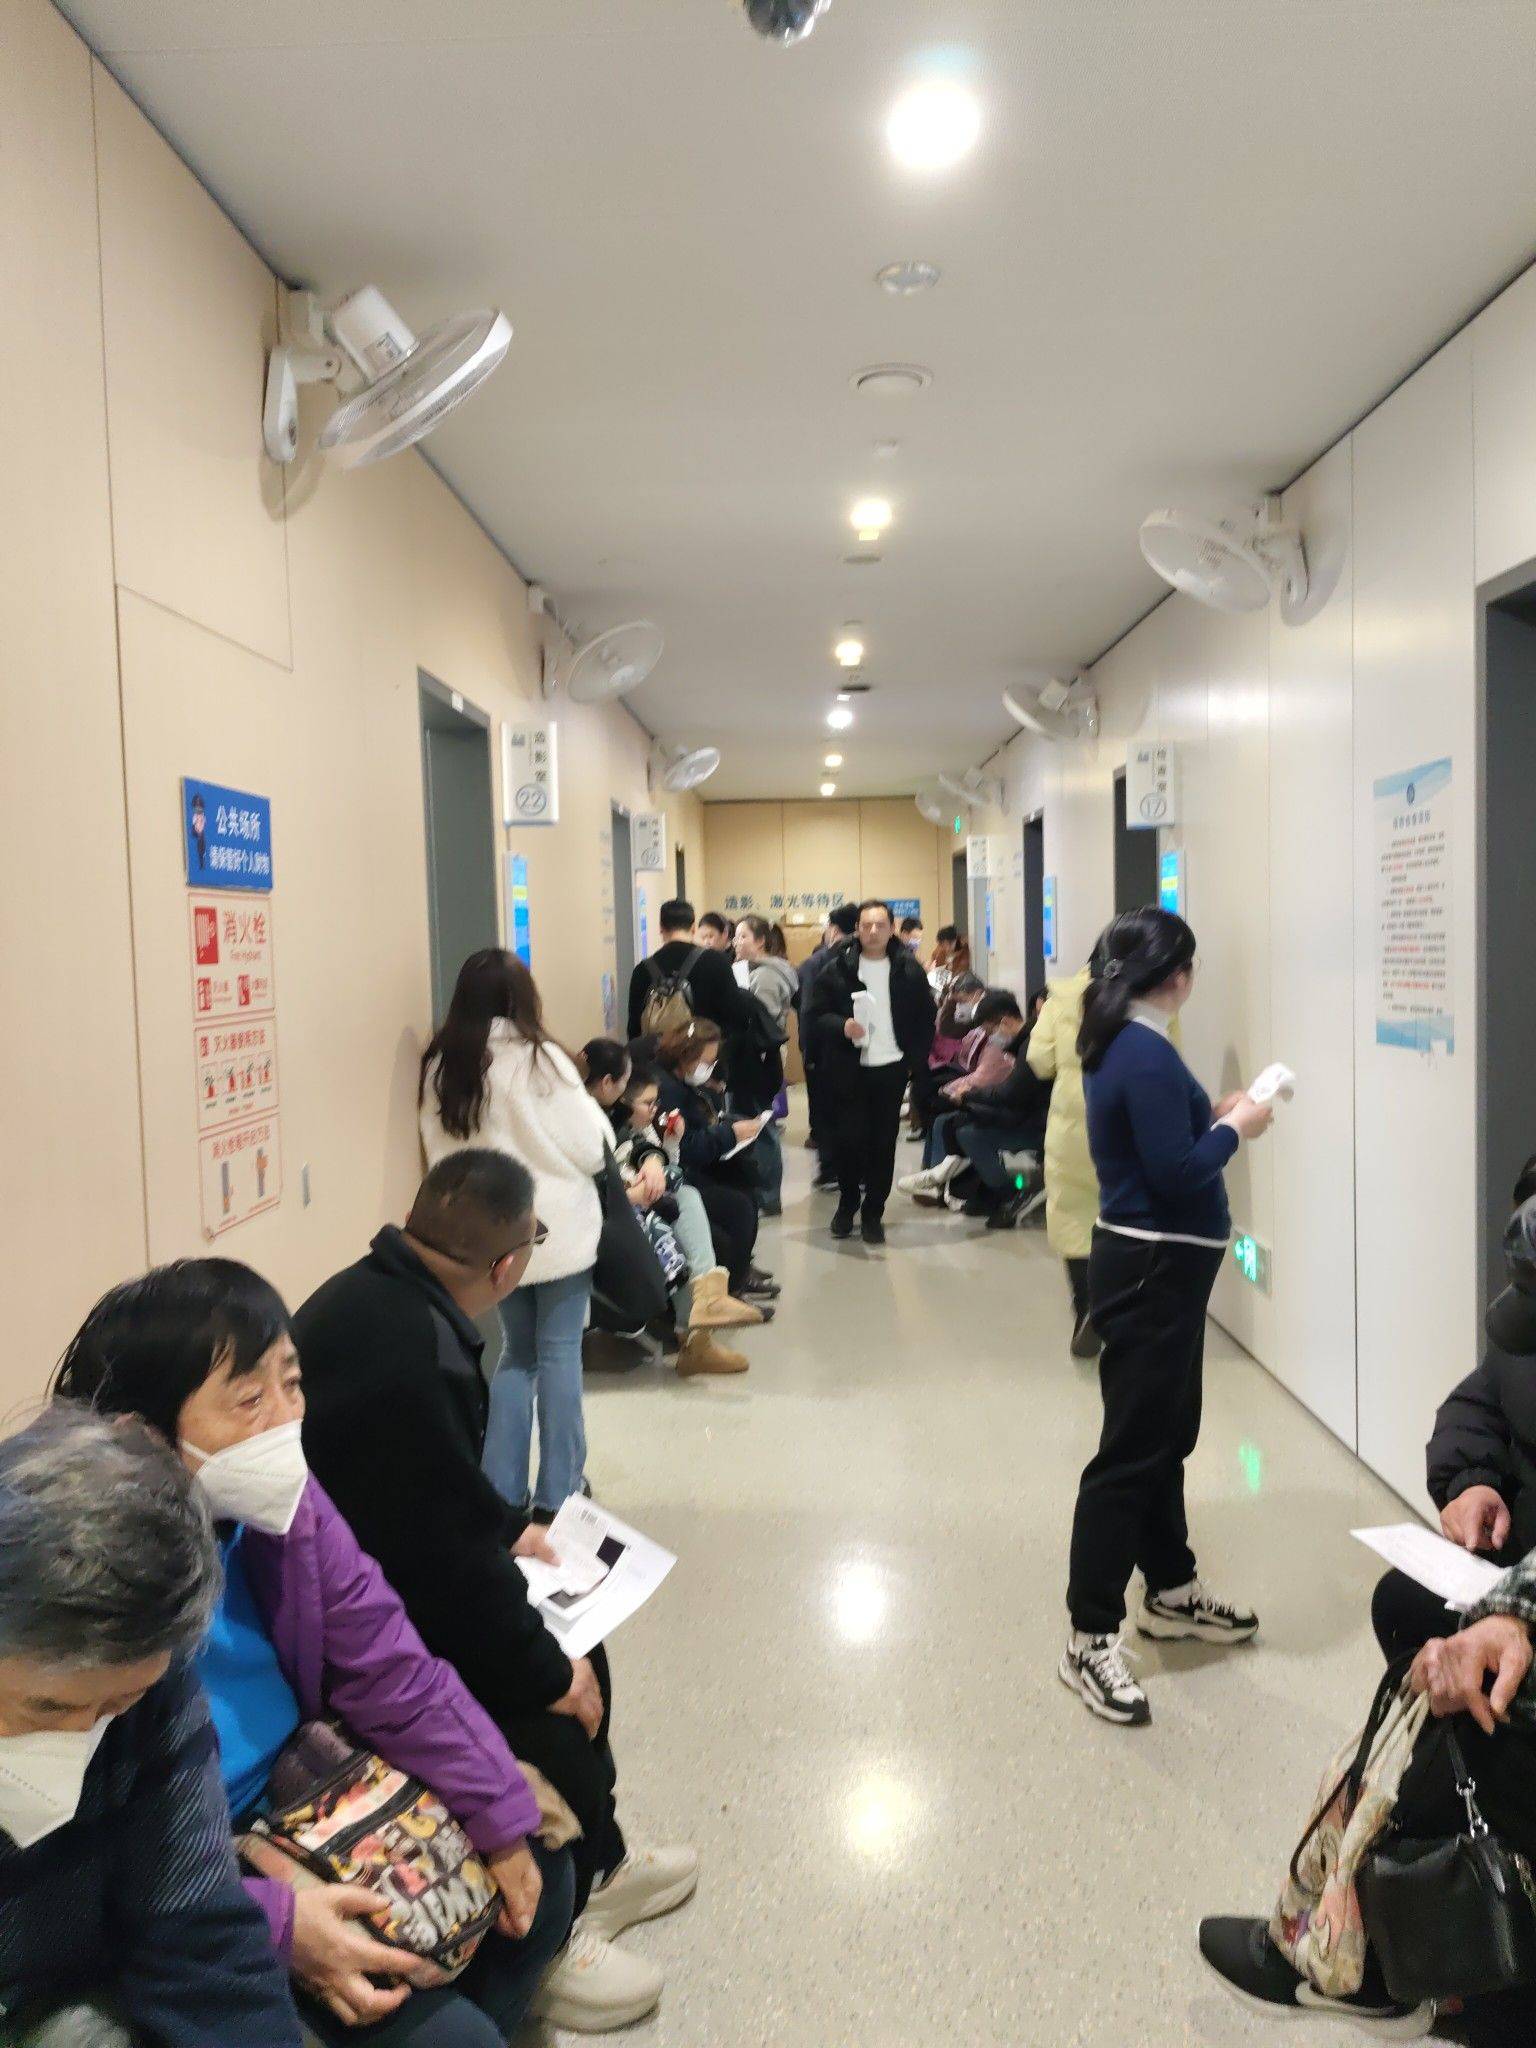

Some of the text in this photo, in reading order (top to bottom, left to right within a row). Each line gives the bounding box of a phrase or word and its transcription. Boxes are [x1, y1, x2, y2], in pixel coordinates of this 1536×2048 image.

[519, 789, 545, 810] 22
[215, 805, 261, 842] 公共场所
